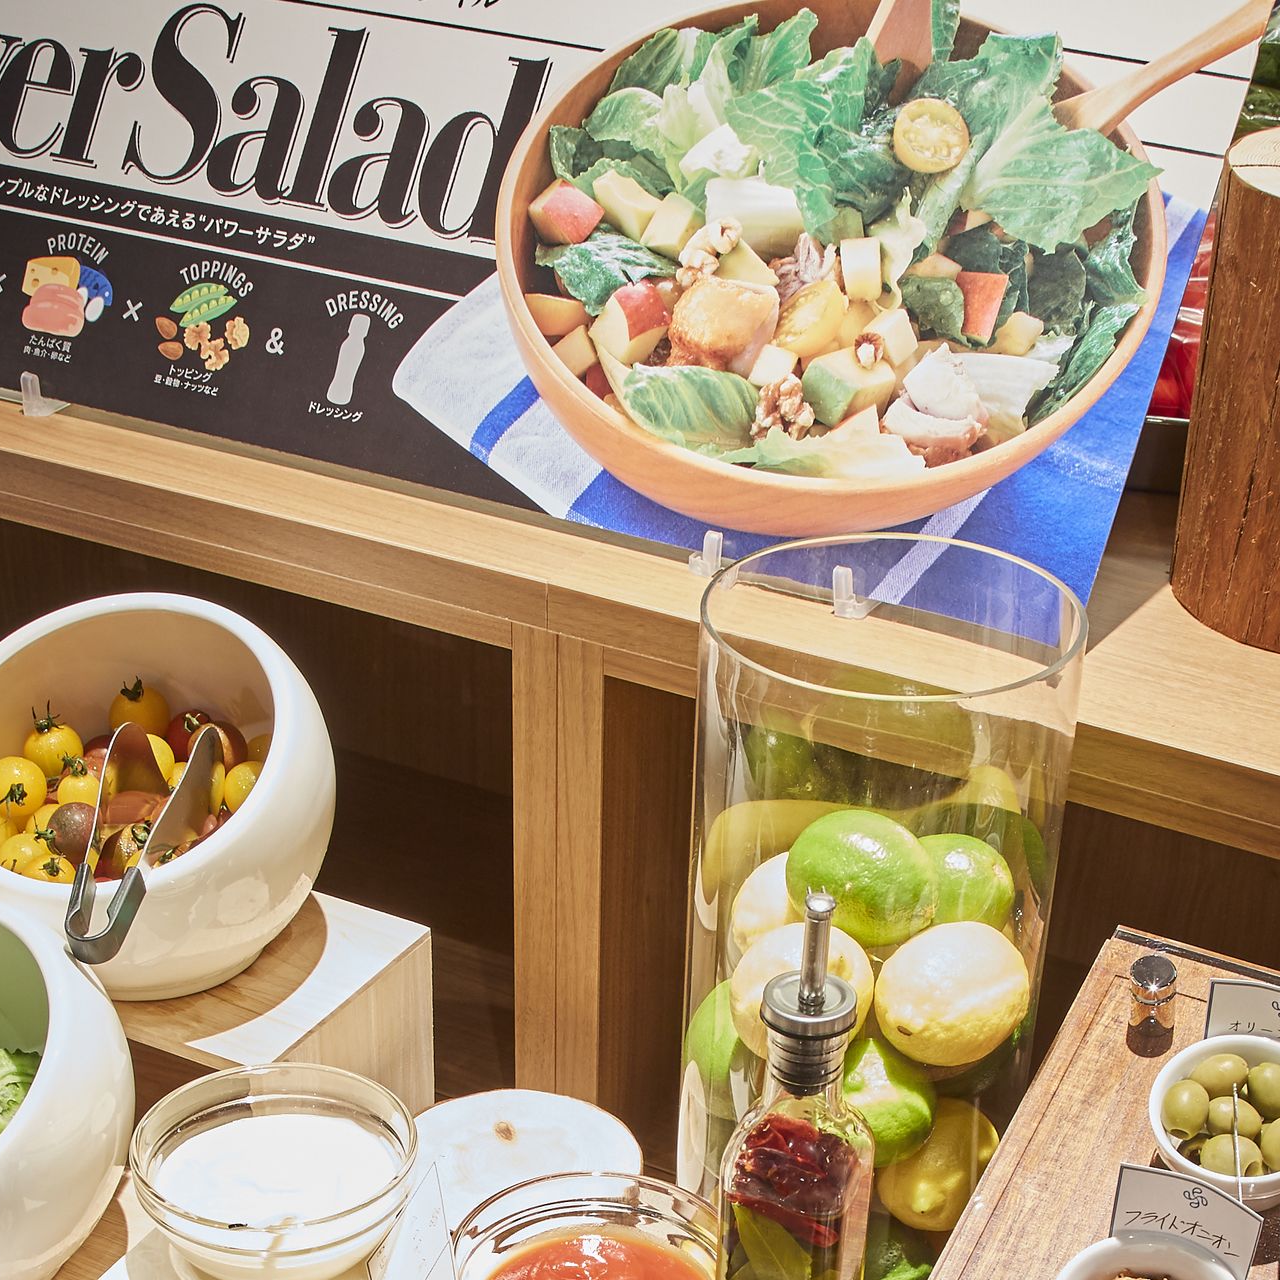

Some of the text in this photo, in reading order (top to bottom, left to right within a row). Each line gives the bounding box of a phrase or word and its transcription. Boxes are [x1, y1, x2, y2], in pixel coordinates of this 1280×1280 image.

[47, 232, 109, 265] PROTEIN
[179, 260, 254, 298] TOPPINGS
[325, 290, 404, 330] DRESSING
[168, 364, 213, 384] トッピング
[308, 400, 363, 423] ドレッシング
[1124, 1210, 1241, 1258] フライドオニオン
